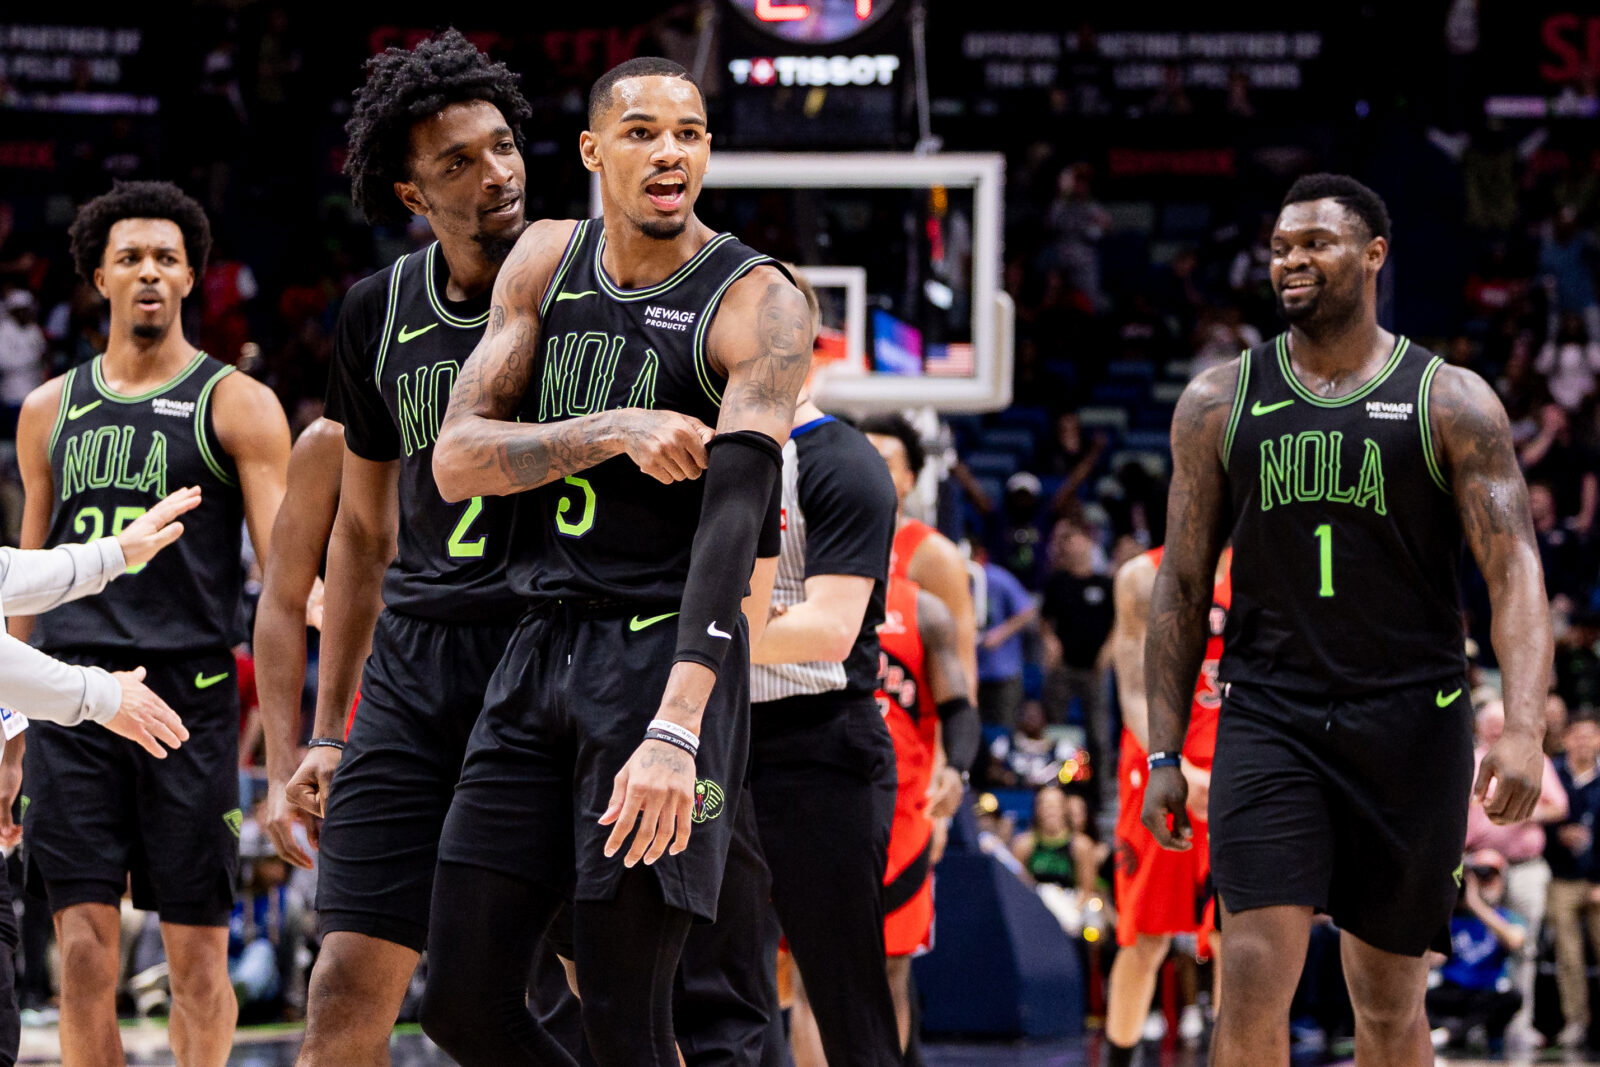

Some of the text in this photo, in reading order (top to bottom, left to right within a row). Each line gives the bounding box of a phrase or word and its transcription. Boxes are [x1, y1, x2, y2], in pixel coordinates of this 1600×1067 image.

[775, 54, 900, 87] TISSOT
[644, 305, 696, 323] NEWAGE
[645, 318, 687, 331] PRODUCTS
[538, 331, 660, 422] NOLA
[152, 398, 195, 412] NEWAGE
[397, 359, 460, 457] NO
[1366, 401, 1413, 414] NEWAGE
[61, 425, 167, 501] NOLA
[1260, 430, 1388, 516] NOLA
[1314, 524, 1335, 597] 1
